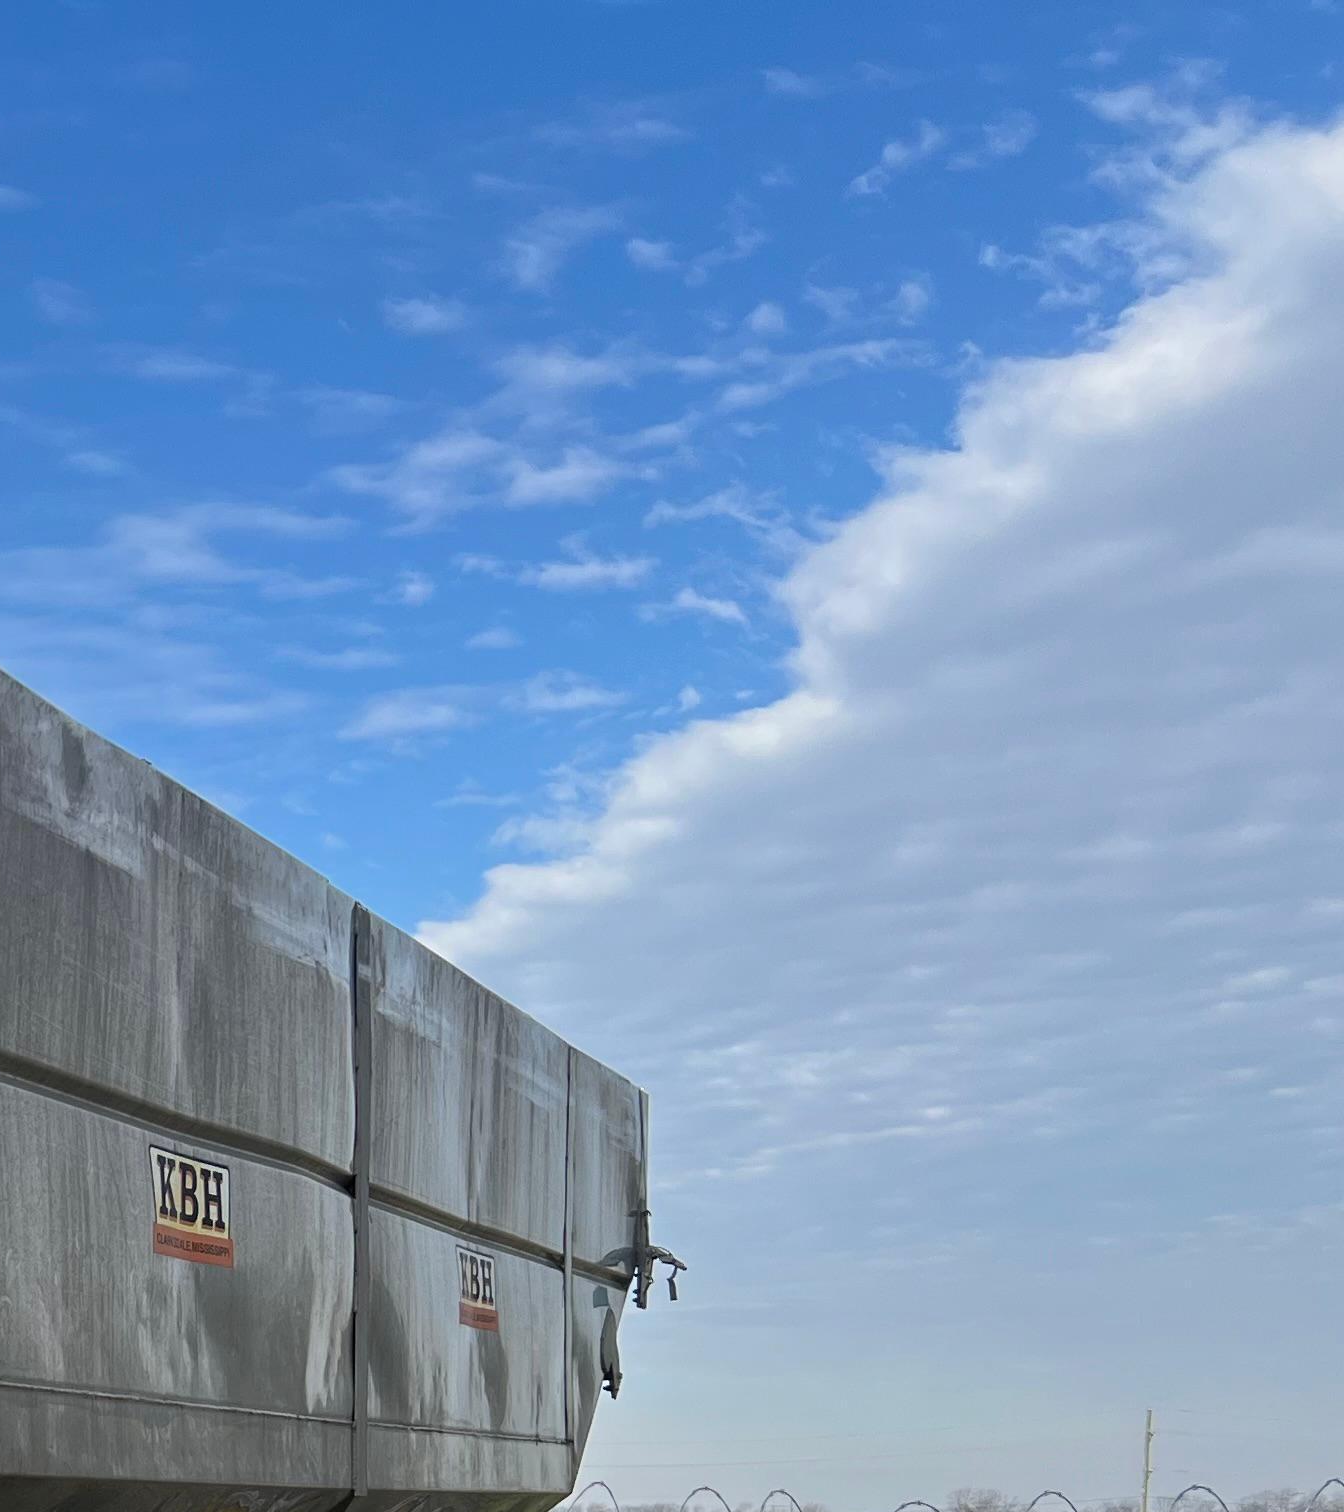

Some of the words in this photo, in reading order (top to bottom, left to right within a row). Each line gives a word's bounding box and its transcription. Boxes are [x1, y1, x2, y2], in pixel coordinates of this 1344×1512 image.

[156, 1154, 226, 1234] KBH
[192, 1242, 230, 1257] MISSISSIPPI
[459, 1252, 494, 1306] KBH
